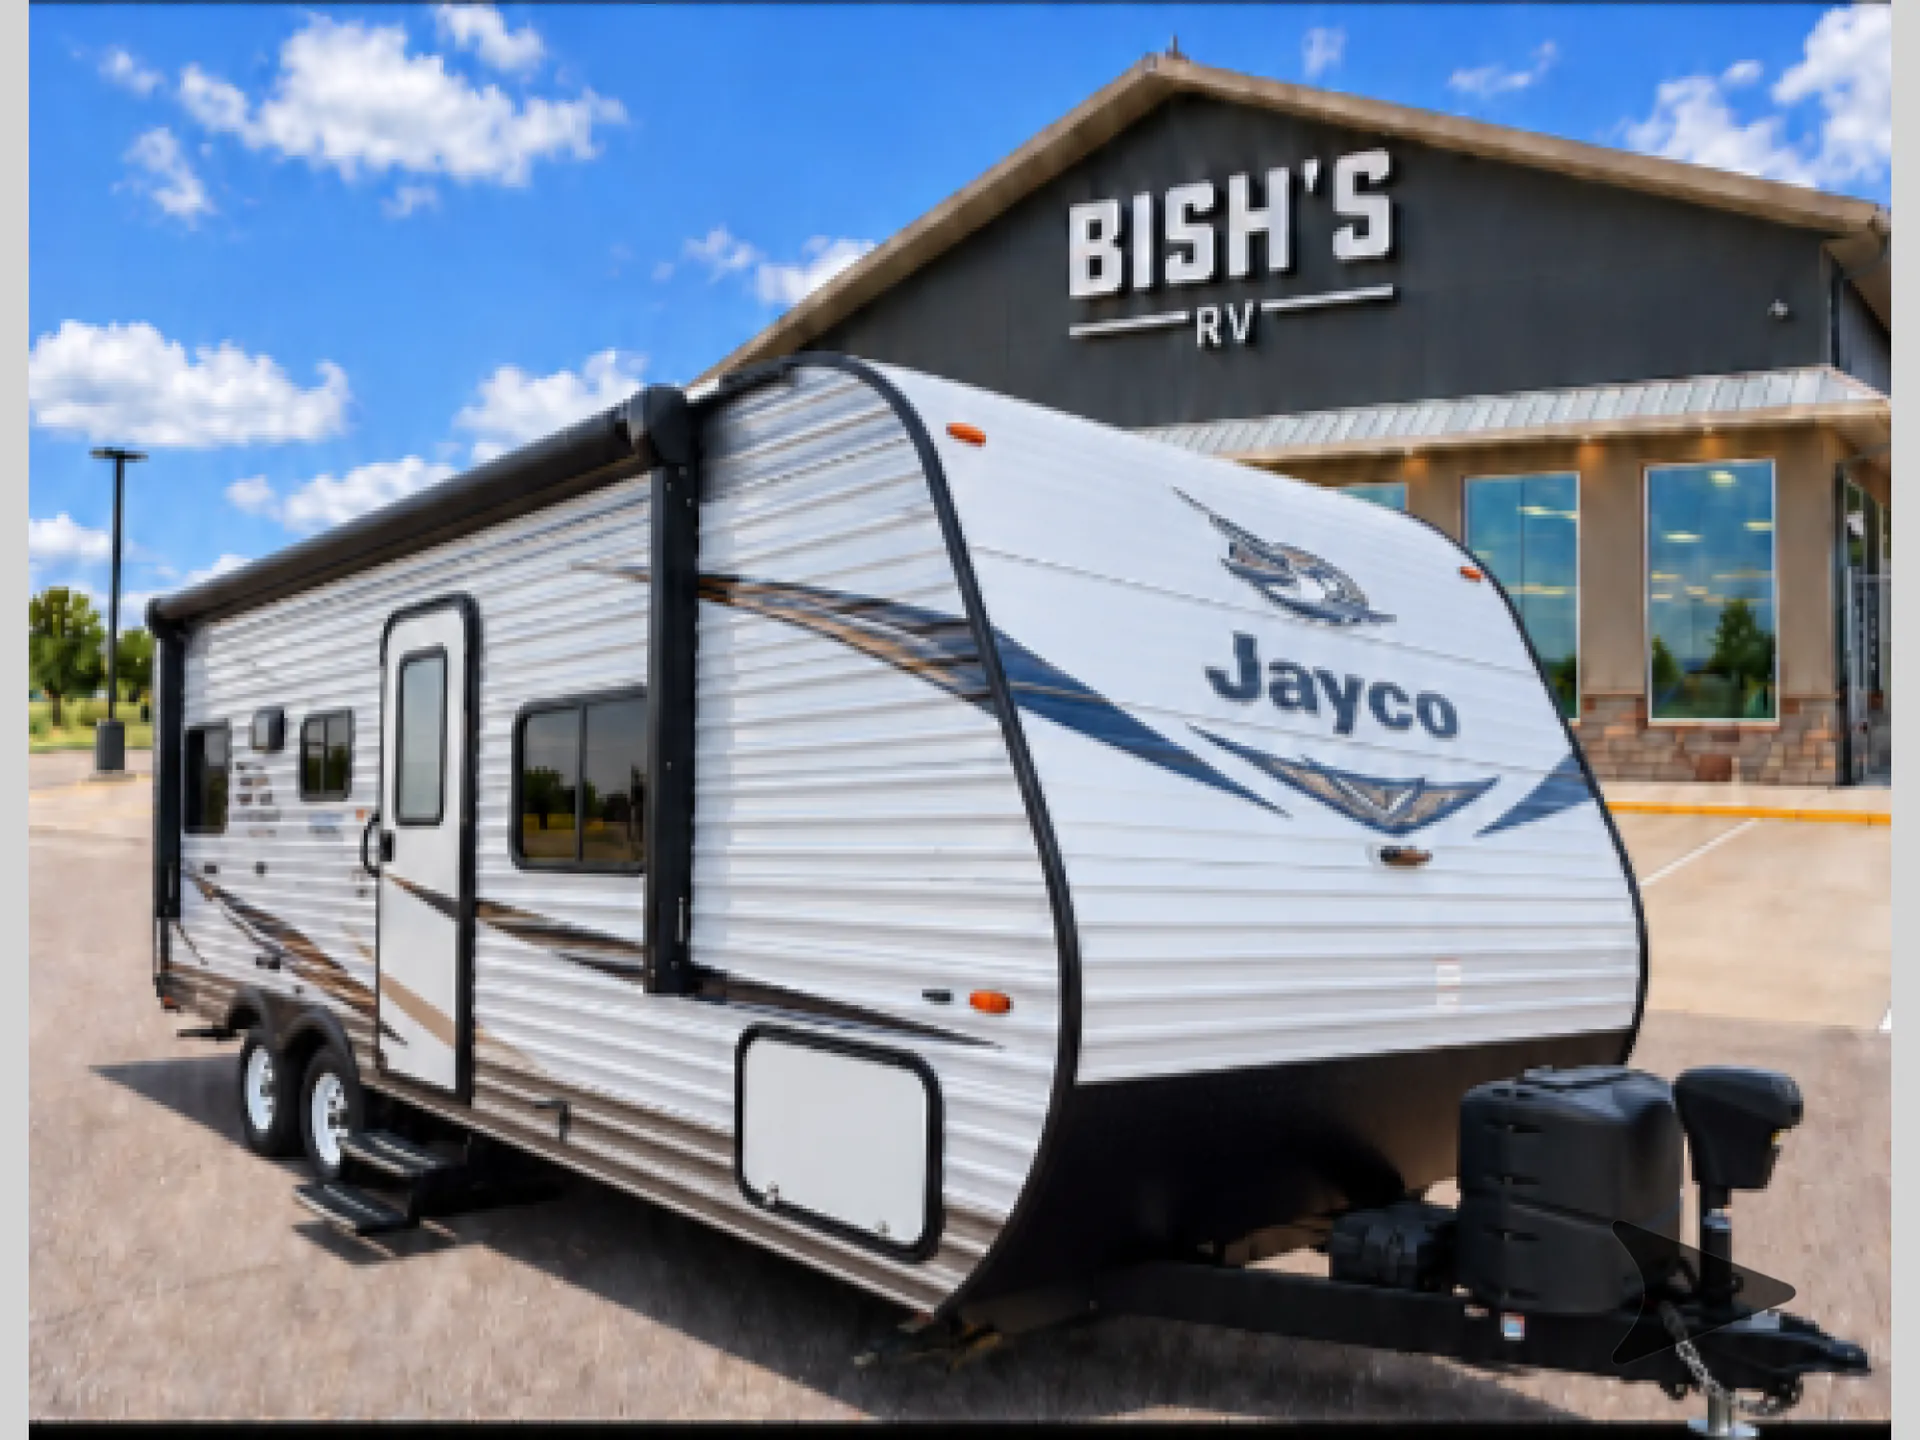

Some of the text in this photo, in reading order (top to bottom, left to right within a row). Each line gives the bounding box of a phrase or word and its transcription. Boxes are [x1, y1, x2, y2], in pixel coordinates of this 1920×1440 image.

[1069, 148, 1392, 297] BISH'S
[1196, 301, 1254, 347] RV
[1205, 631, 1459, 739] Jayco
